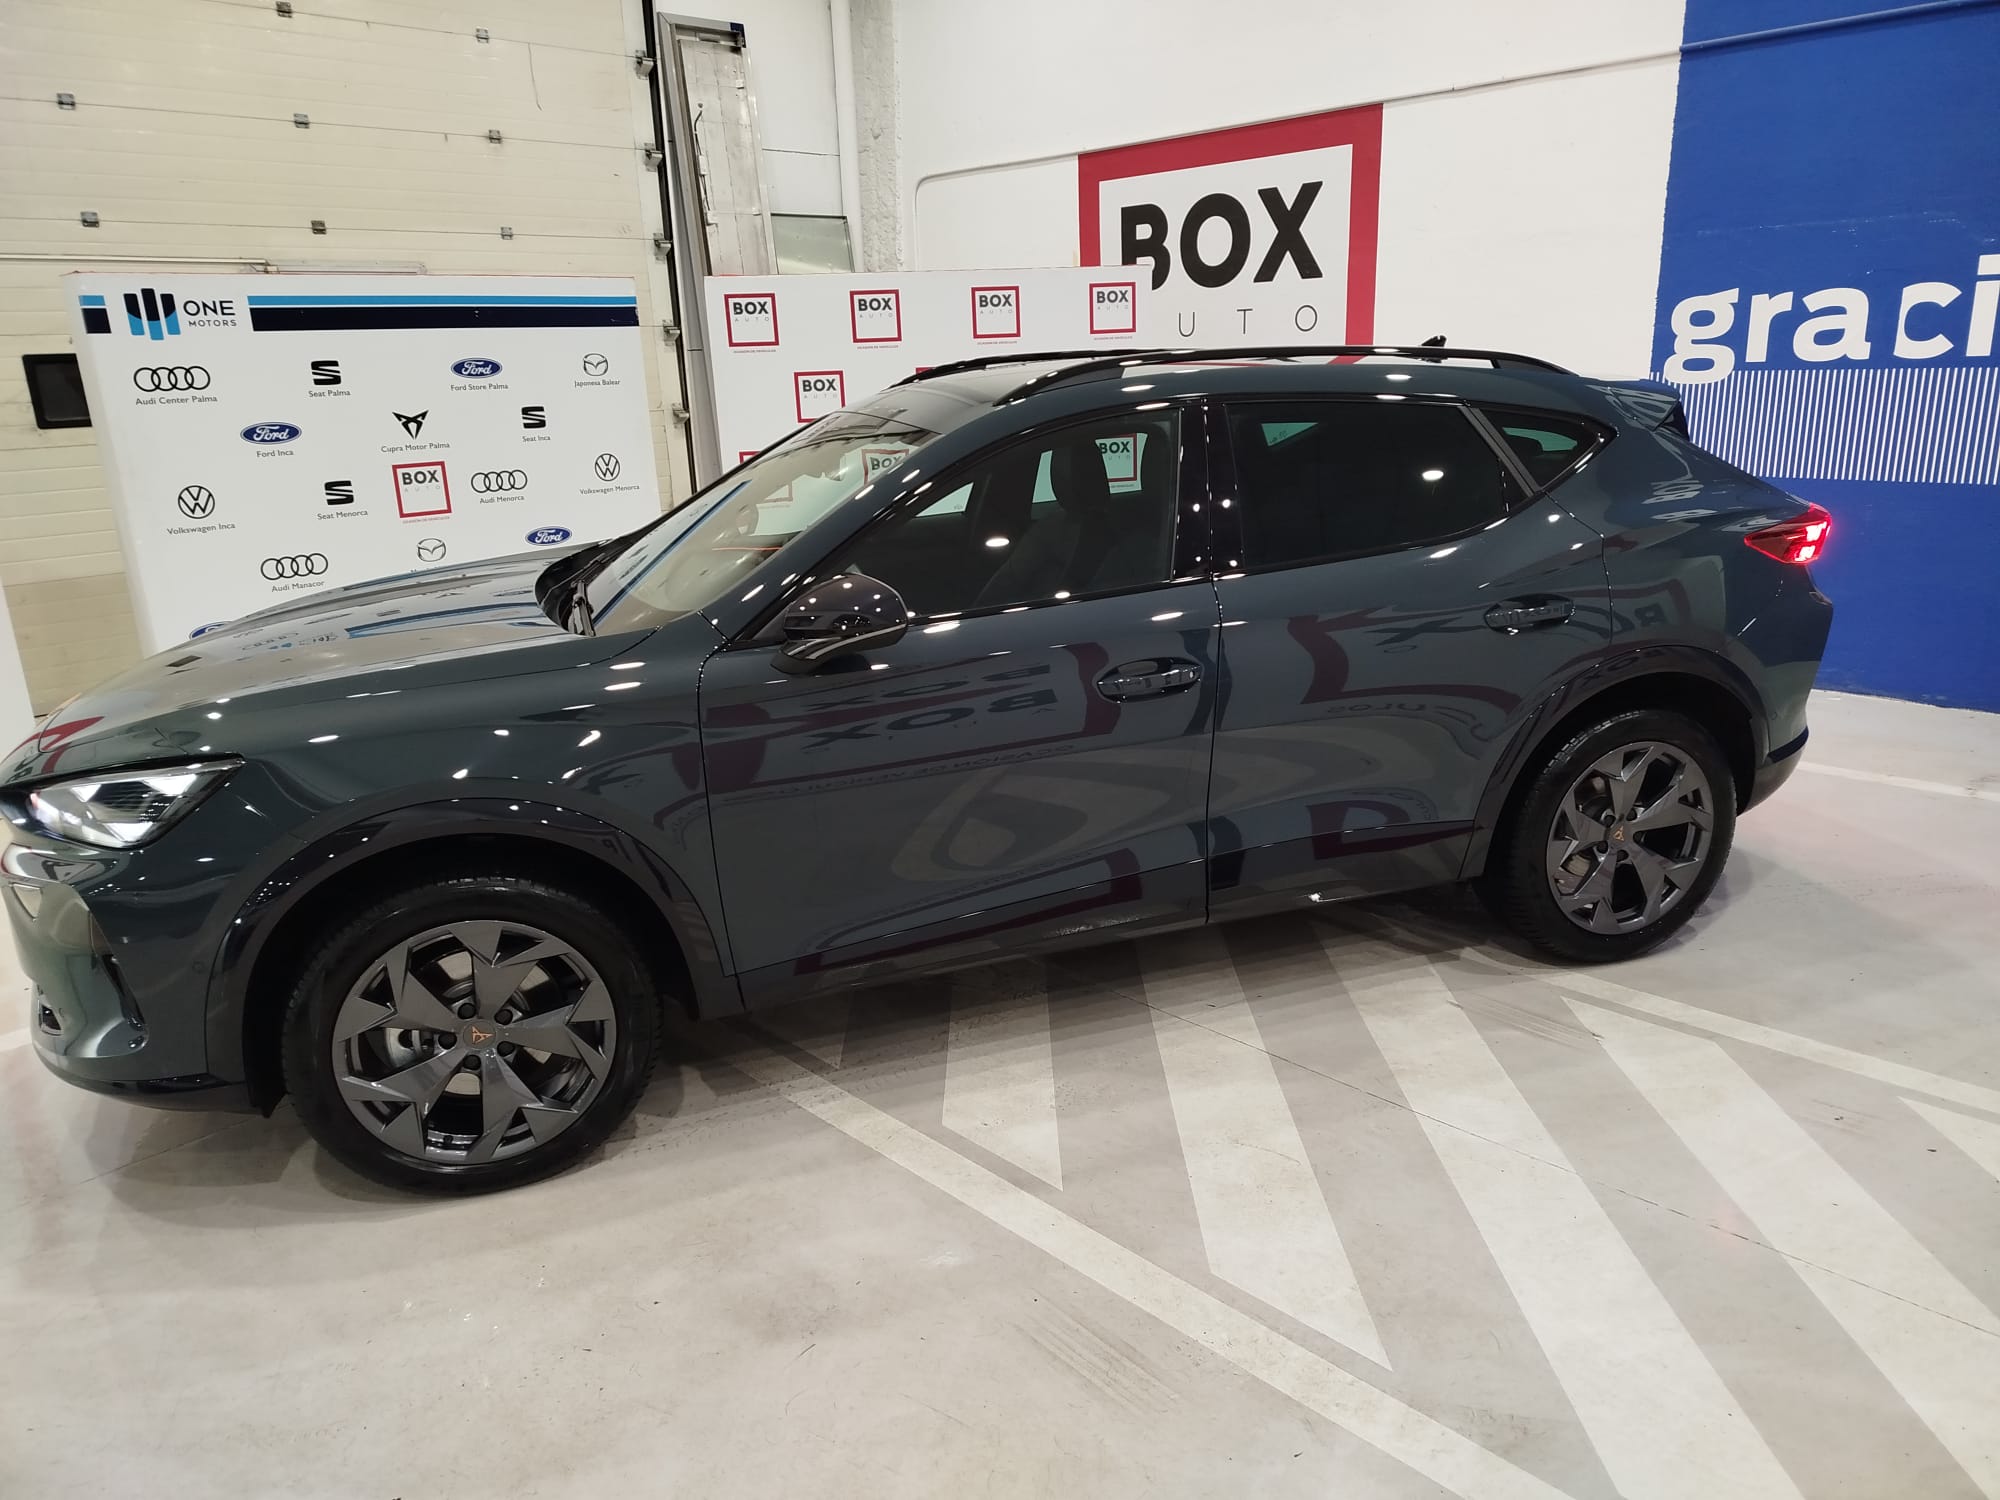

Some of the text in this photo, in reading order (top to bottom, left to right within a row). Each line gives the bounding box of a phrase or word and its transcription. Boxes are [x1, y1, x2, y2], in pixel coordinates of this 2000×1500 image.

[1121, 181, 1323, 290] BOX
[979, 294, 1012, 308] BOX
[1096, 290, 1129, 304] BOX
[183, 300, 236, 316] ONE
[733, 301, 769, 315] BOX
[858, 297, 893, 312] BOX
[188, 319, 237, 327] MOTORS
[1178, 305, 1317, 337] UTO
[468, 383, 487, 391] Store
[574, 379, 621, 388] Japonesa Balear
[802, 378, 837, 392] BOX
[135, 394, 218, 406] Audi Center Palma
[308, 389, 351, 398] Seat Palma
[522, 434, 551, 443] Seat Inca
[256, 449, 295, 458] Ford Inca
[381, 441, 451, 454] Cupra Motor Palma
[1099, 441, 1130, 454] BOX
[401, 469, 440, 485] BOX
[579, 484, 640, 496] Volkswagen Menorca
[479, 494, 525, 505] Audi Menorca
[317, 509, 368, 521] Seat Menorca
[167, 522, 236, 535] Volkswagen Inca
[271, 580, 325, 593] Audi Manacor
